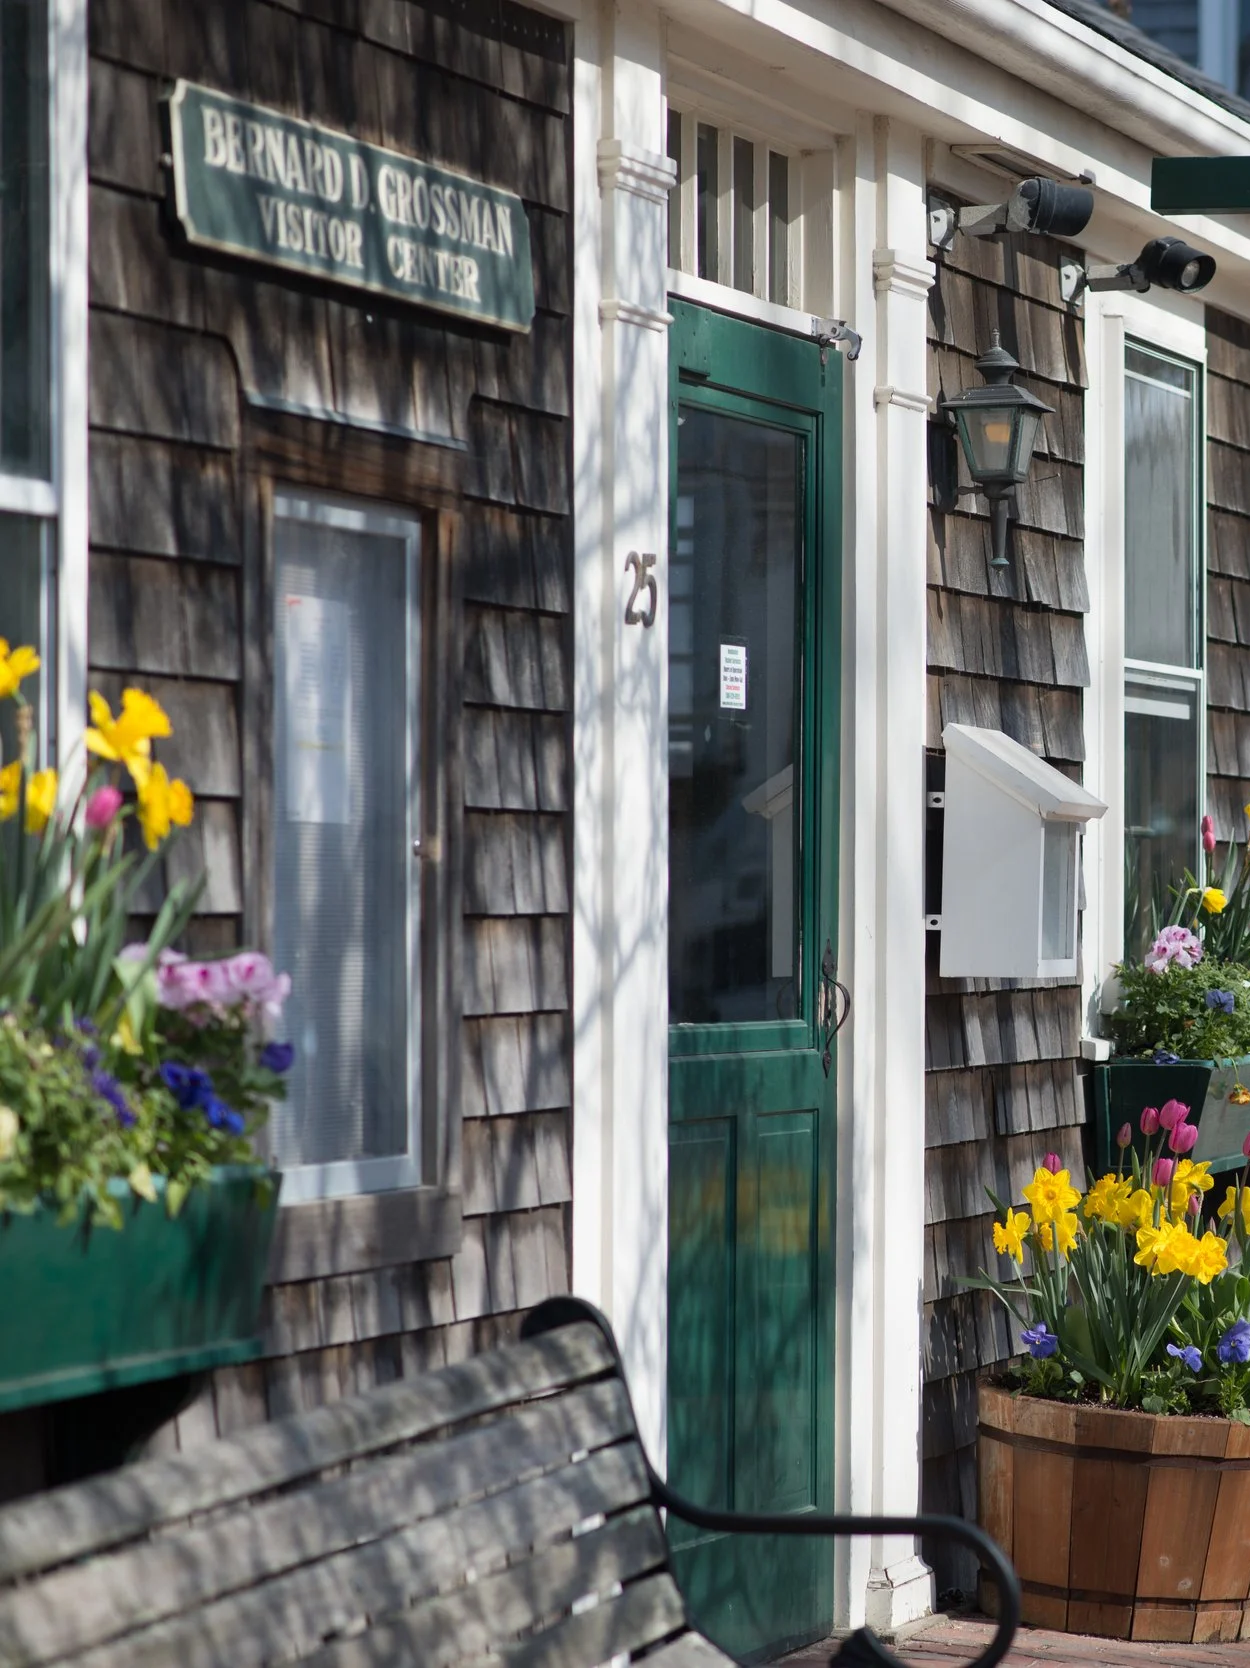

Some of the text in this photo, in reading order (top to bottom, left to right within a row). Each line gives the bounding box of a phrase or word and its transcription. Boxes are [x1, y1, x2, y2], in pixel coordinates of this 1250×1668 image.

[202, 106, 514, 257] BERNARD D. GROSSMAN
[257, 194, 481, 303] VISITOR CENTER
[624, 550, 657, 628] 25
